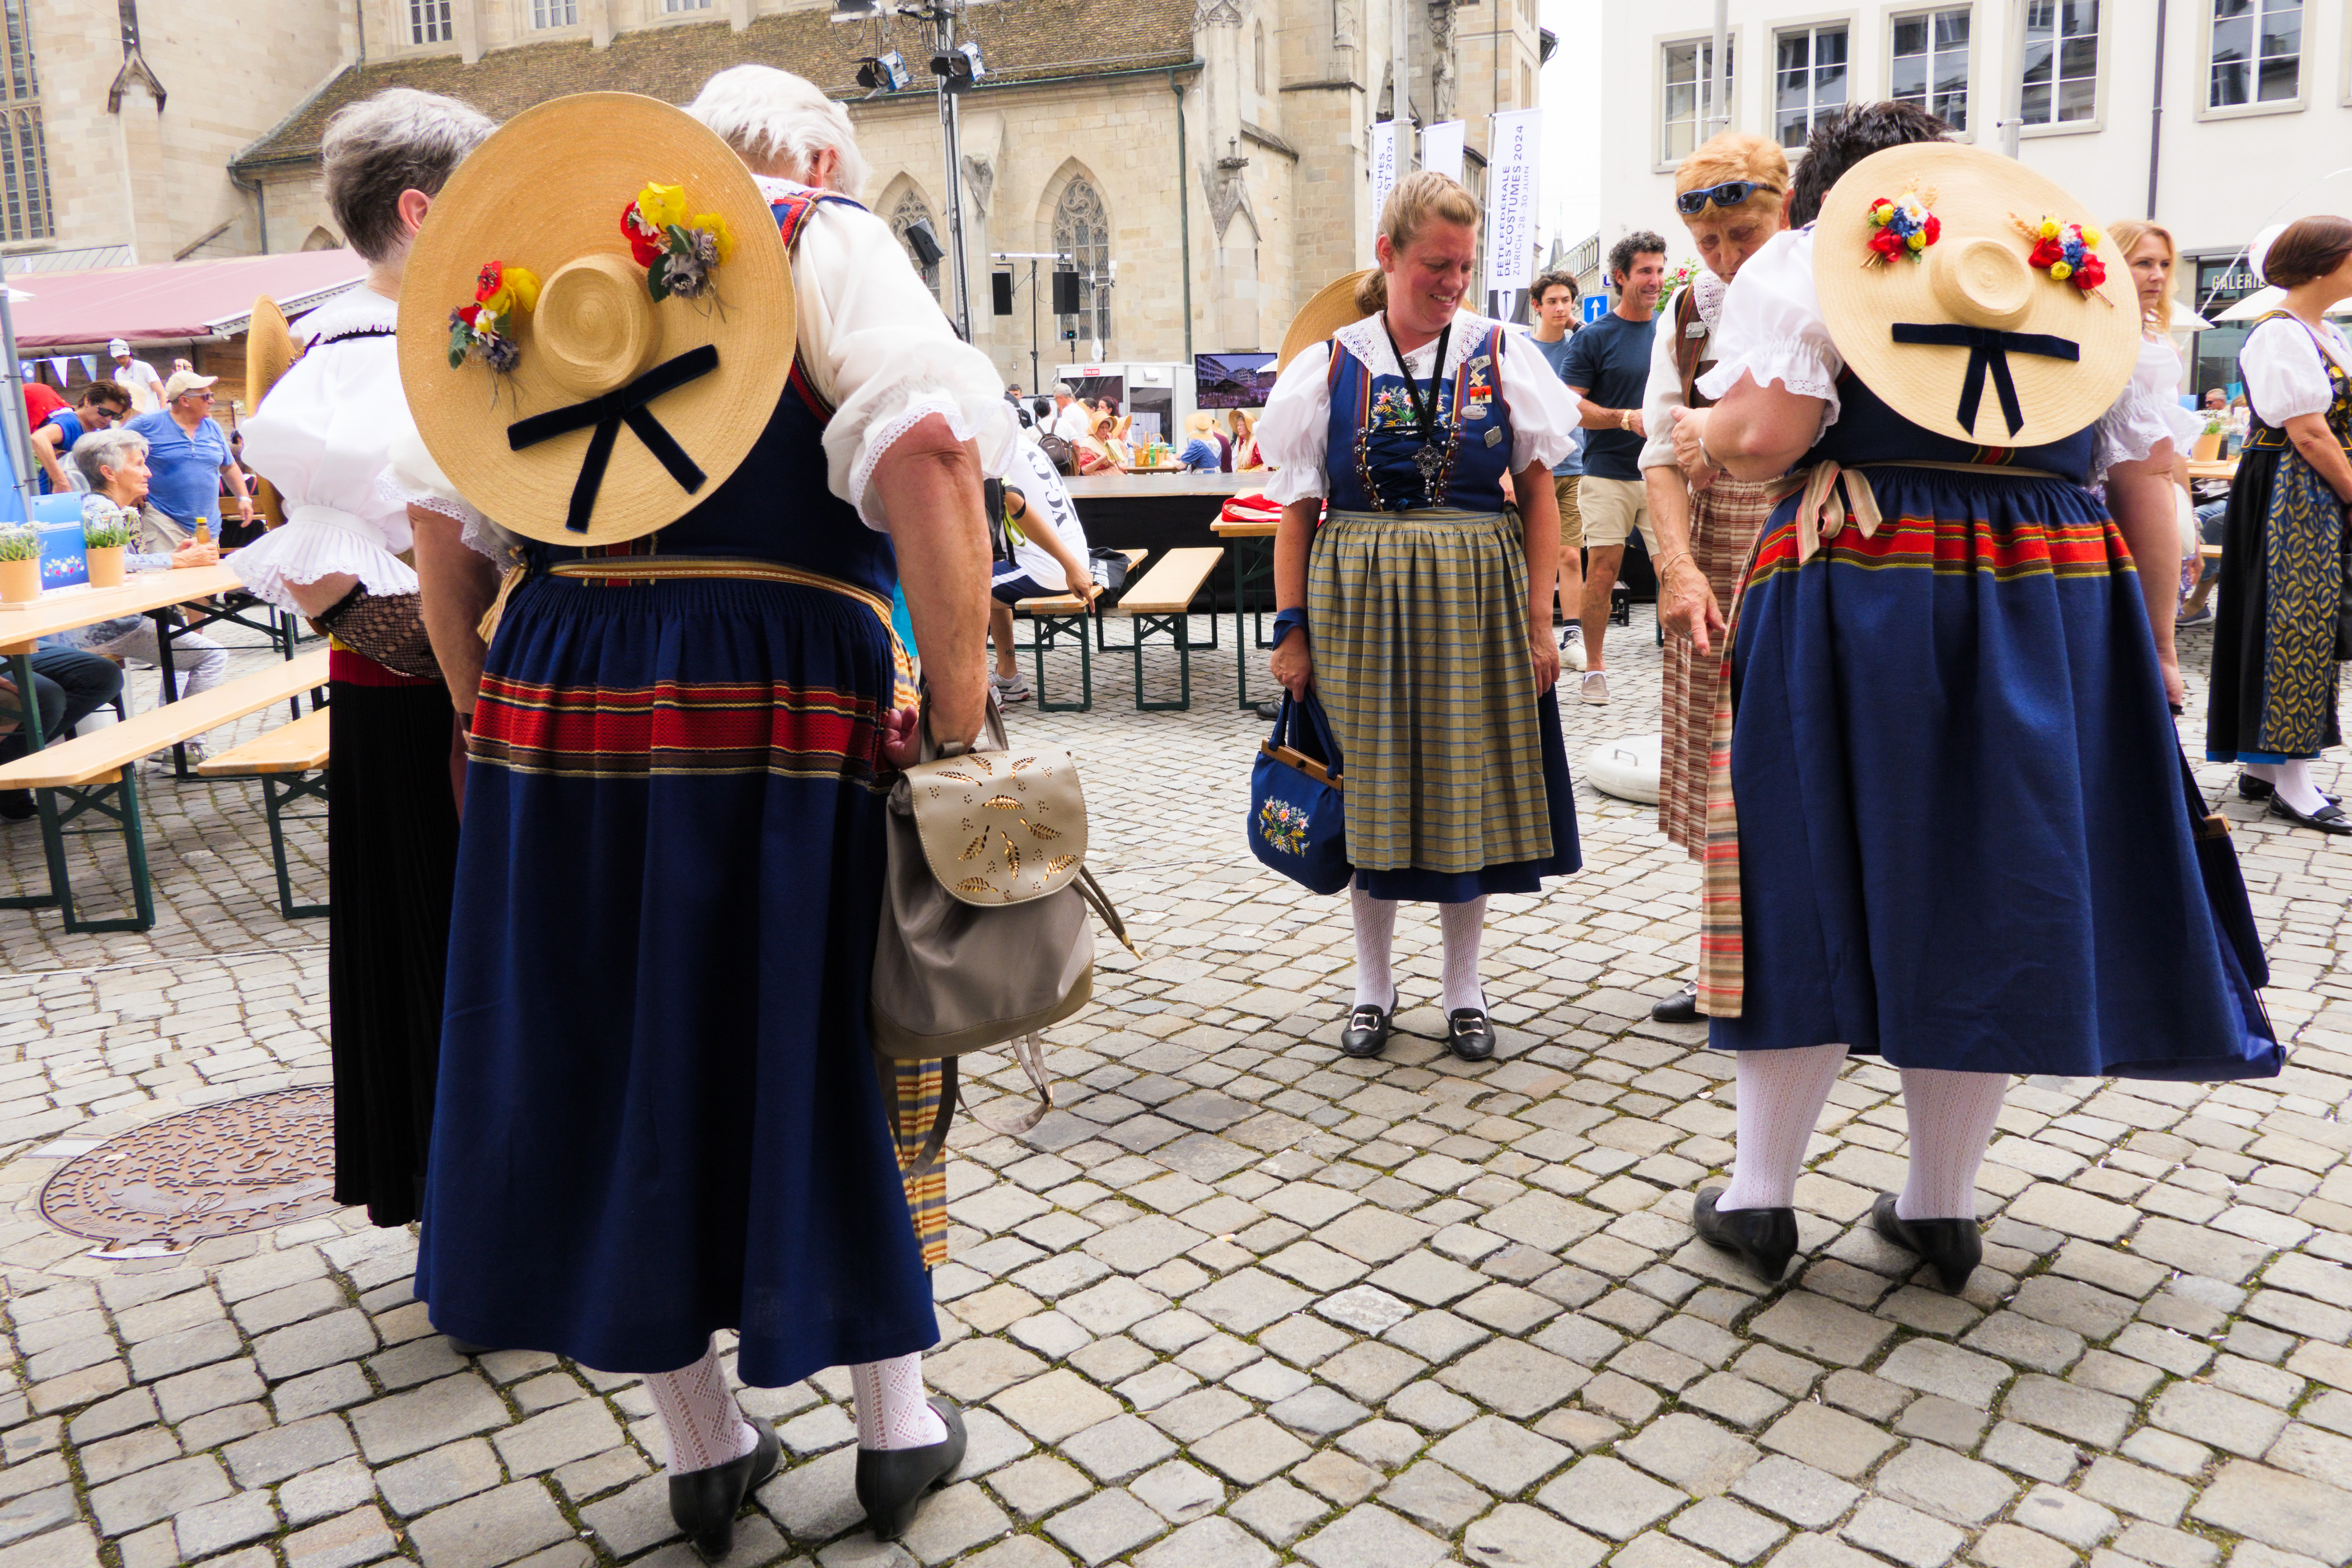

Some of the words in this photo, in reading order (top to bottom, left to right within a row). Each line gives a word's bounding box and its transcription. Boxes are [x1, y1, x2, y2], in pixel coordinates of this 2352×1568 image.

[1499, 166, 1510, 238] FÉDÉRALE
[1505, 166, 1521, 245] COSTUMES
[1514, 125, 1523, 161] 2024
